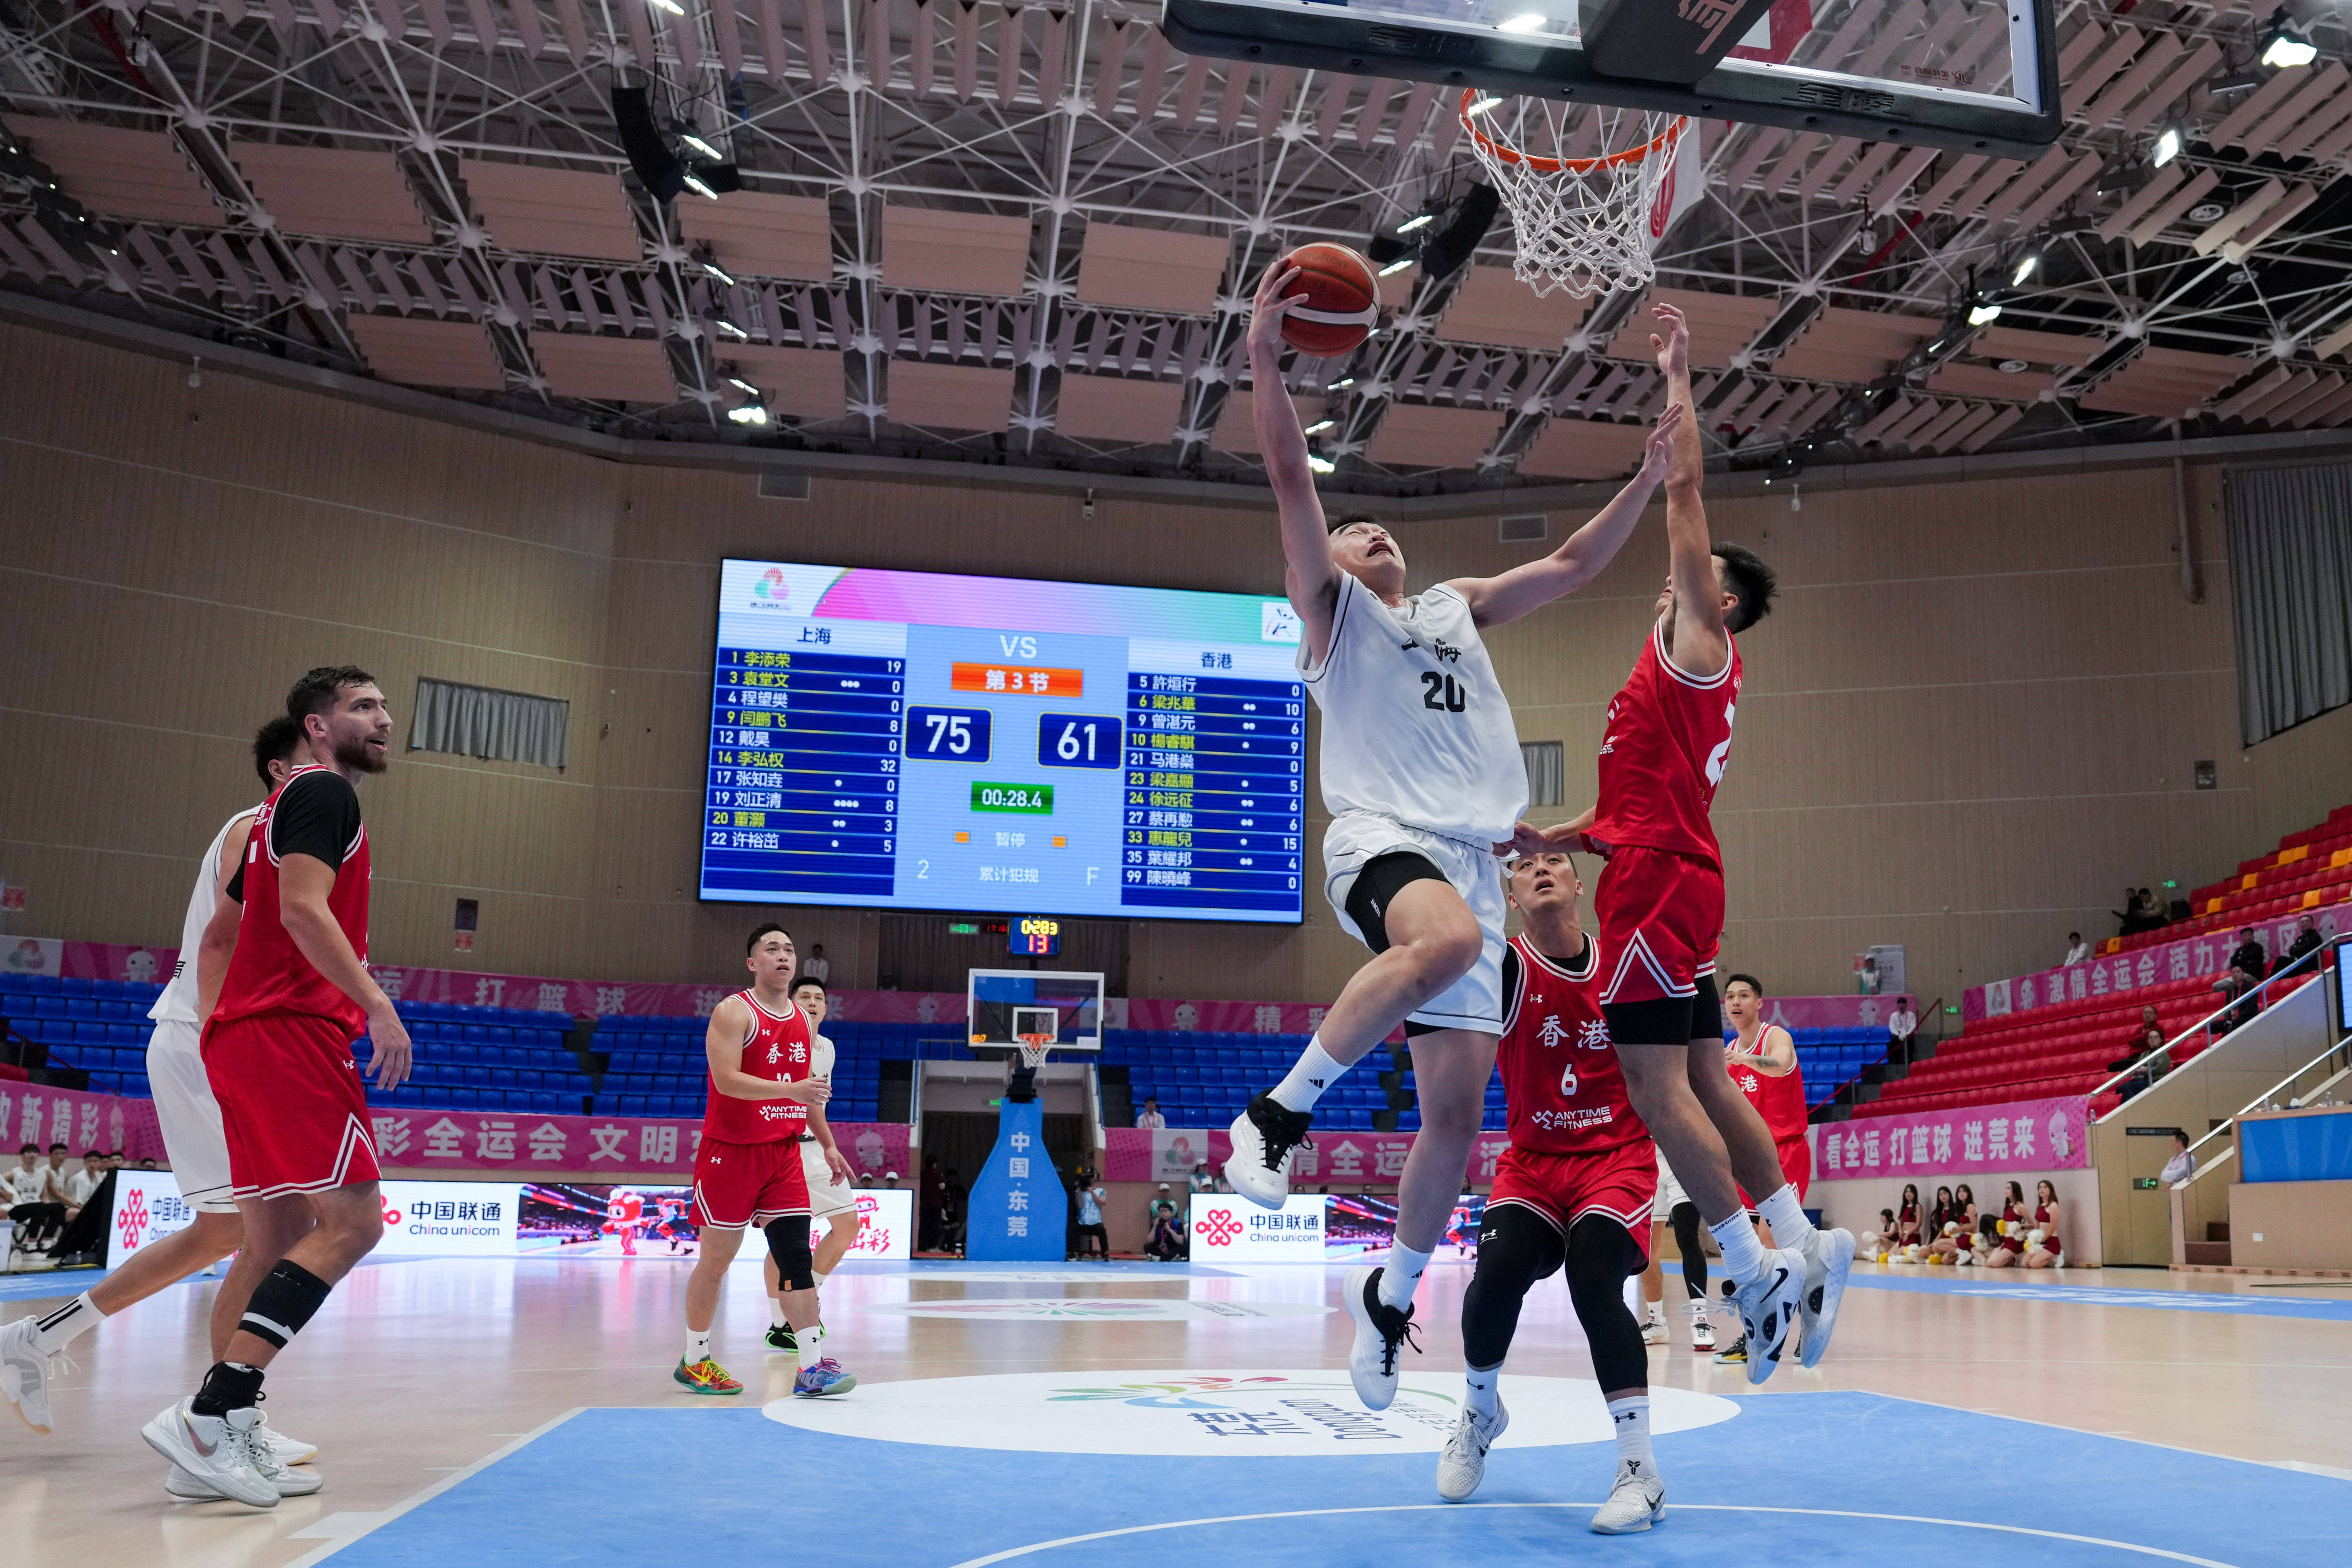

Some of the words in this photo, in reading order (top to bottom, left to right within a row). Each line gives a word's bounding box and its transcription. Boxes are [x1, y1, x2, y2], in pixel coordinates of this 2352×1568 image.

[797, 627, 832, 645] 上海
[1000, 635, 1038, 658] VS
[732, 651, 738, 663] 1
[744, 651, 790, 668] 李添荣
[887, 661, 901, 673] 19
[1201, 652, 1232, 669] 香港
[730, 671, 738, 684] 3
[892, 680, 900, 693] 0
[985, 669, 1006, 690] 第
[1029, 672, 1049, 693] 节
[1140, 676, 1147, 688] 5
[1292, 685, 1299, 697] 0
[1421, 671, 1465, 712] 20
[728, 691, 737, 703] 4
[891, 700, 899, 712] 0
[1139, 695, 1147, 708] 6
[1285, 703, 1299, 716] 10
[727, 711, 735, 724] 9
[740, 710, 787, 728] 闫鹏飞
[890, 720, 898, 732] 8
[1138, 714, 1146, 726] 9
[1291, 722, 1299, 735] 6
[719, 730, 734, 743] 12
[889, 740, 897, 752] 0
[927, 715, 971, 754] 75
[1057, 722, 1096, 761] 61
[1132, 733, 1146, 746] 10
[1291, 741, 1298, 754] 9
[718, 751, 732, 764] 14
[738, 751, 784, 768] 李弘权
[880, 759, 896, 772] 32
[1130, 753, 1143, 765] 21
[1290, 760, 1298, 773] 0
[716, 771, 731, 784] 17
[887, 780, 895, 792] 0
[1130, 772, 1144, 785] 23
[1290, 780, 1298, 792] 5
[715, 791, 730, 804] 19
[734, 790, 782, 808] 刘正清
[885, 800, 894, 812] 8
[982, 788, 1042, 808] 00:28.4
[1129, 792, 1144, 804] 24
[1149, 791, 1194, 808] 徐远征
[1290, 799, 1297, 812] 6
[713, 811, 728, 824] 20
[884, 820, 892, 832] 3
[1128, 812, 1144, 824] 27
[1289, 818, 1297, 831] 6
[711, 832, 727, 845] 22
[884, 840, 891, 852] 5
[1128, 831, 1143, 843] 33
[1283, 837, 1297, 851] 15
[917, 860, 930, 879] 2
[1127, 851, 1142, 863] 35
[1147, 850, 1192, 867] 葉耀邦
[1288, 858, 1296, 870] 4
[979, 866, 1039, 883] 累计犯规
[1087, 867, 1099, 885] F
[1127, 870, 1141, 883] 99
[1288, 876, 1296, 890] 0
[1029, 934, 1048, 954] 13
[2049, 955, 2155, 1003] 激情全运会
[1536, 1015, 1611, 1050] 香港
[766, 1041, 807, 1064] 香港
[1561, 1064, 1577, 1096] 6
[1740, 1075, 1758, 1092] 港
[1554, 1106, 1611, 1120] ANYTIME
[1554, 1115, 1613, 1130] FITNESS
[371, 1117, 567, 1161] 彩全运会
[1823, 1130, 1880, 1169] 看全运
[1890, 1122, 1952, 1165] 打篮球
[1963, 1115, 2035, 1162] 进莞来
[411, 1201, 501, 1221] 中国联通
[410, 1224, 447, 1235] China
[451, 1225, 500, 1235] unicom
[1250, 1214, 1319, 1230] 中国联通
[1250, 1233, 1279, 1242] China
[1281, 1234, 1319, 1242] unicom
[1187, 1411, 1312, 1436] 东莞
[1278, 1399, 1403, 1440] Dongguan
